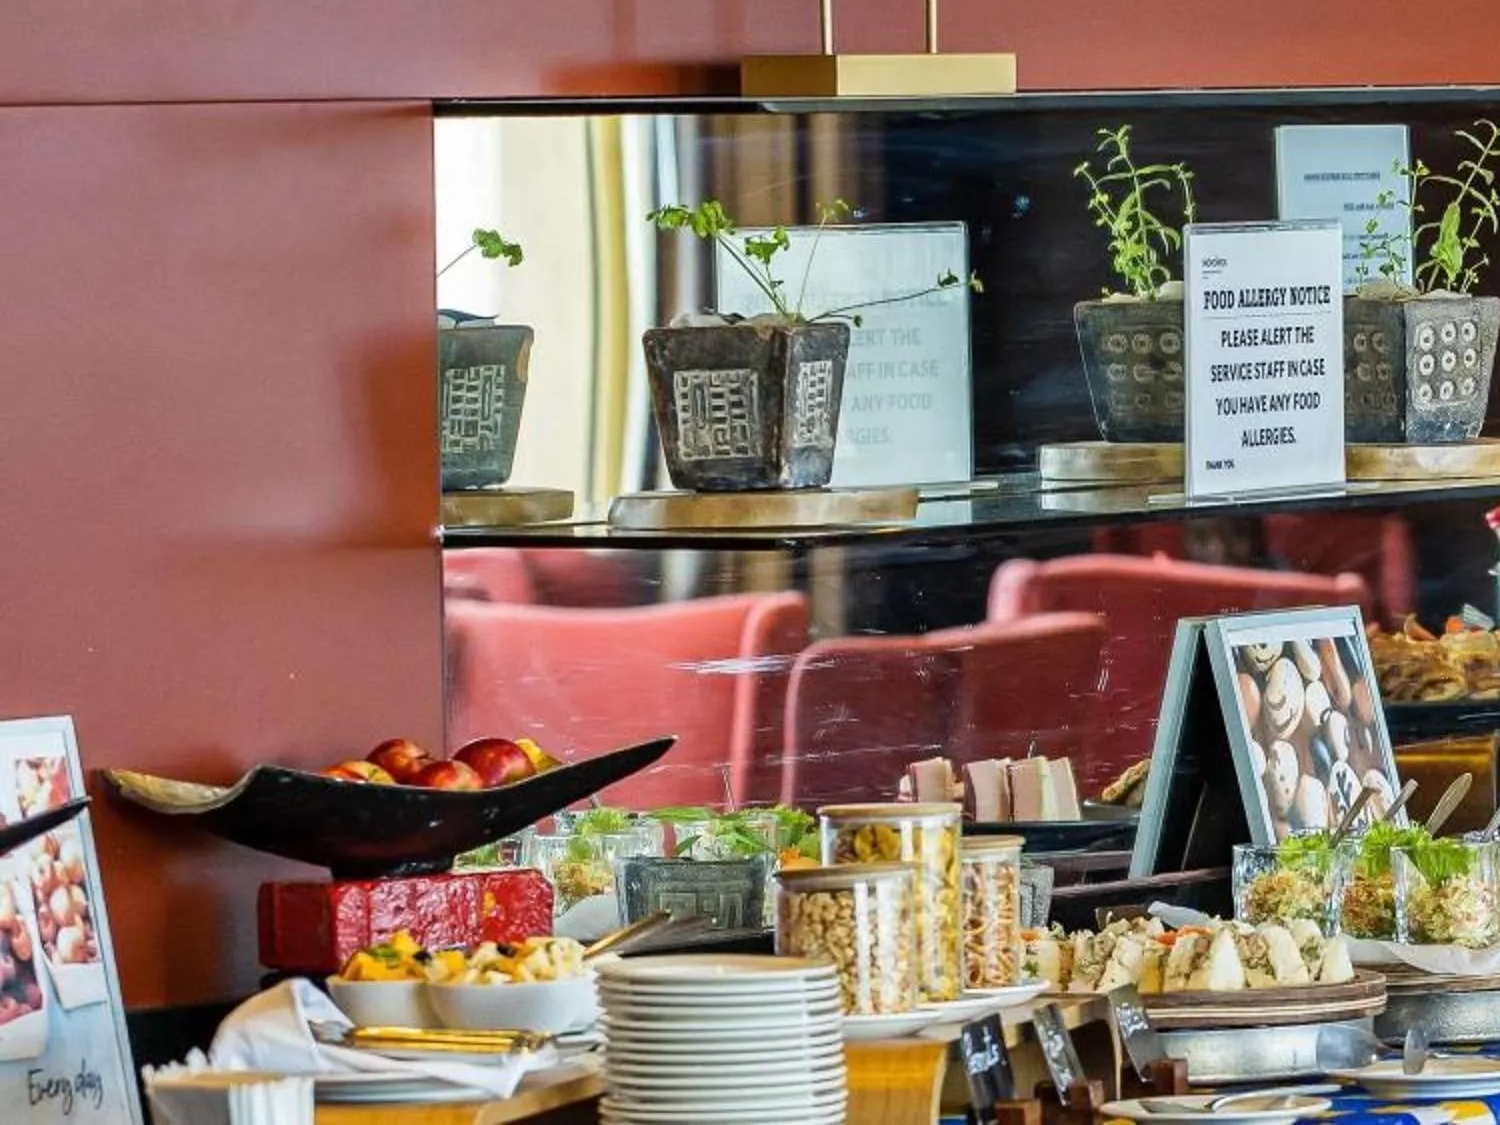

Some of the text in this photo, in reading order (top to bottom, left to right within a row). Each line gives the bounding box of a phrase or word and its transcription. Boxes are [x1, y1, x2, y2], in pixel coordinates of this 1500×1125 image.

[1203, 285, 1331, 310] FOOD ALLERGY NOTICE
[1221, 326, 1315, 348] PLEASE ALERT THE
[1210, 358, 1326, 383] SERVICE STAFF IN CASE
[1215, 392, 1321, 416] YOU HAVE ANY FOOD
